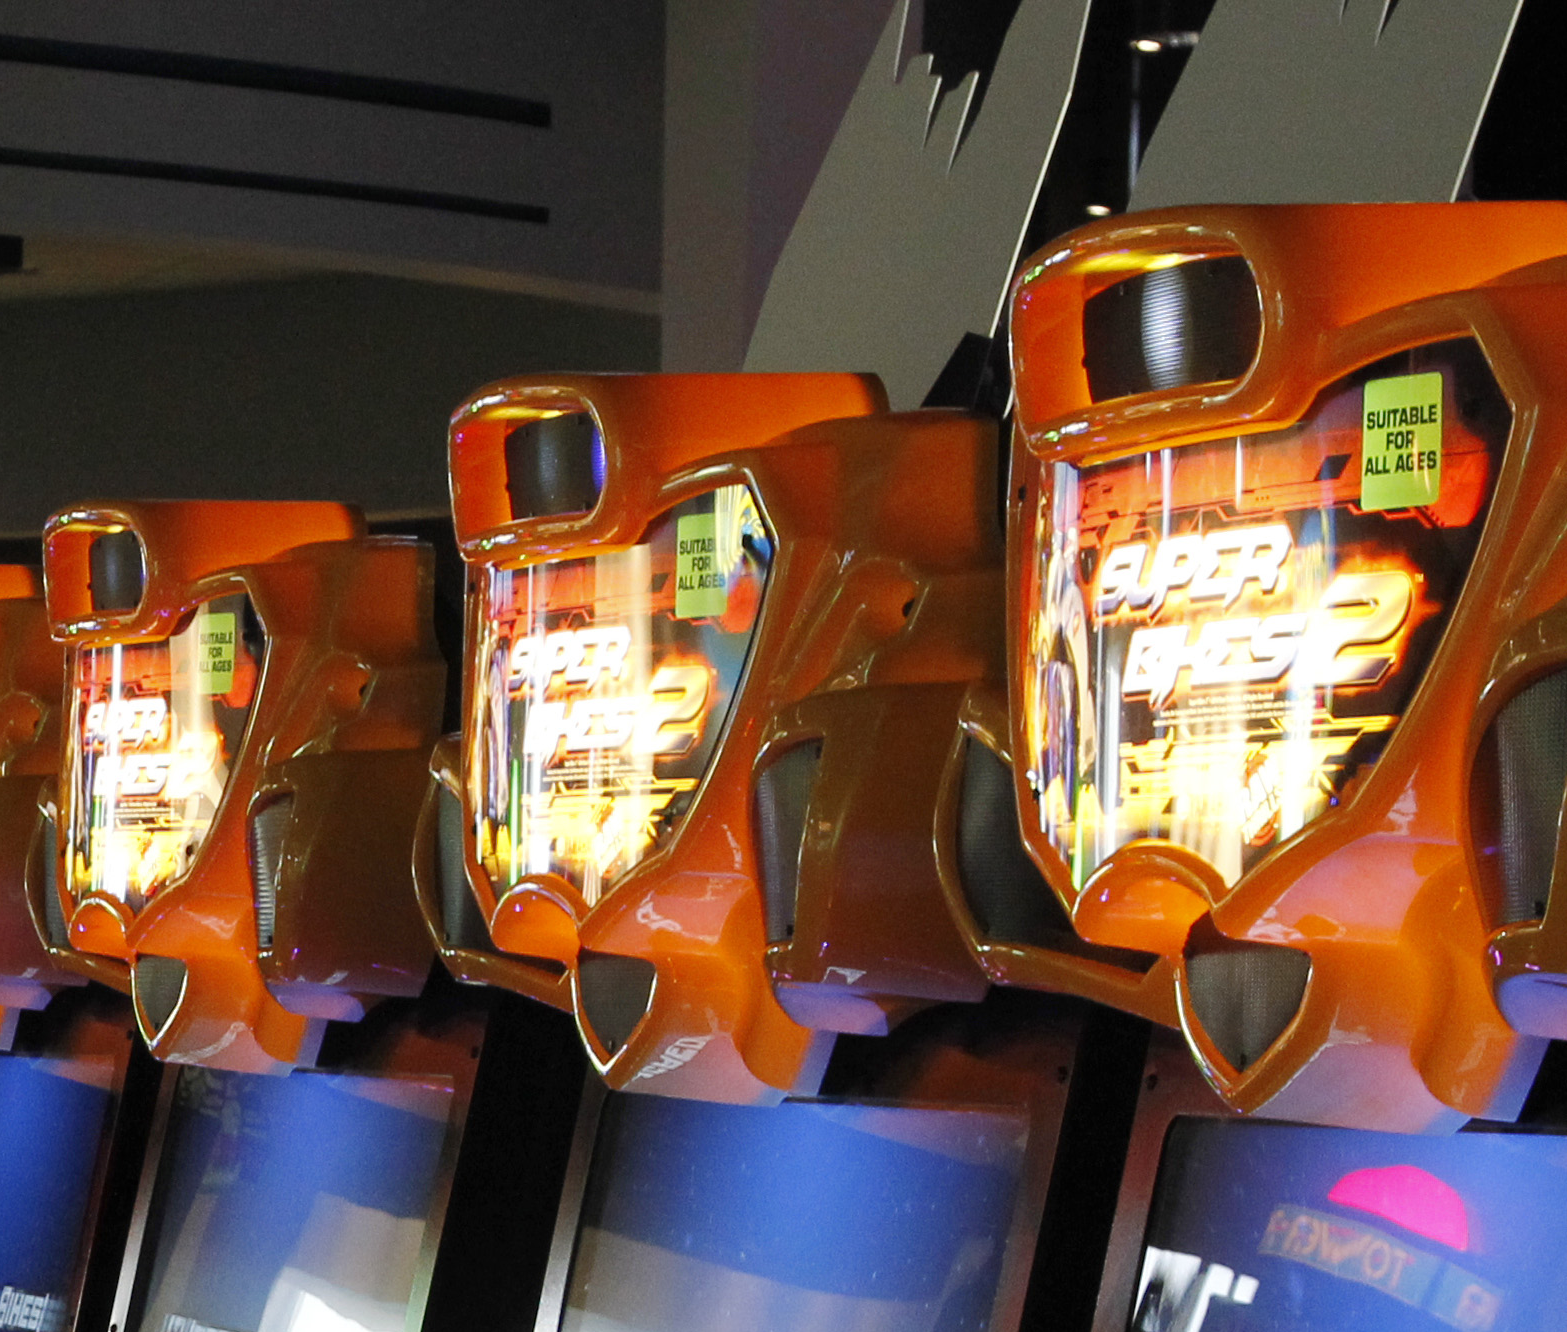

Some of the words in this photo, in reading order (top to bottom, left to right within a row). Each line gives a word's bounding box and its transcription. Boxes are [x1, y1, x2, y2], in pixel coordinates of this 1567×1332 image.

[1367, 404, 1437, 430] SUITABLE
[1386, 430, 1415, 451] FOR
[1365, 455, 1390, 476] ALL
[1395, 451, 1437, 473] AGES
[692, 556, 711, 572] FOR
[1094, 521, 1294, 624] SUPER
[678, 575, 694, 590] ALL
[698, 573, 725, 589] AGES
[1122, 613, 1307, 710] BIKES
[1317, 570, 1414, 686] 2
[637, 665, 709, 753] 2
